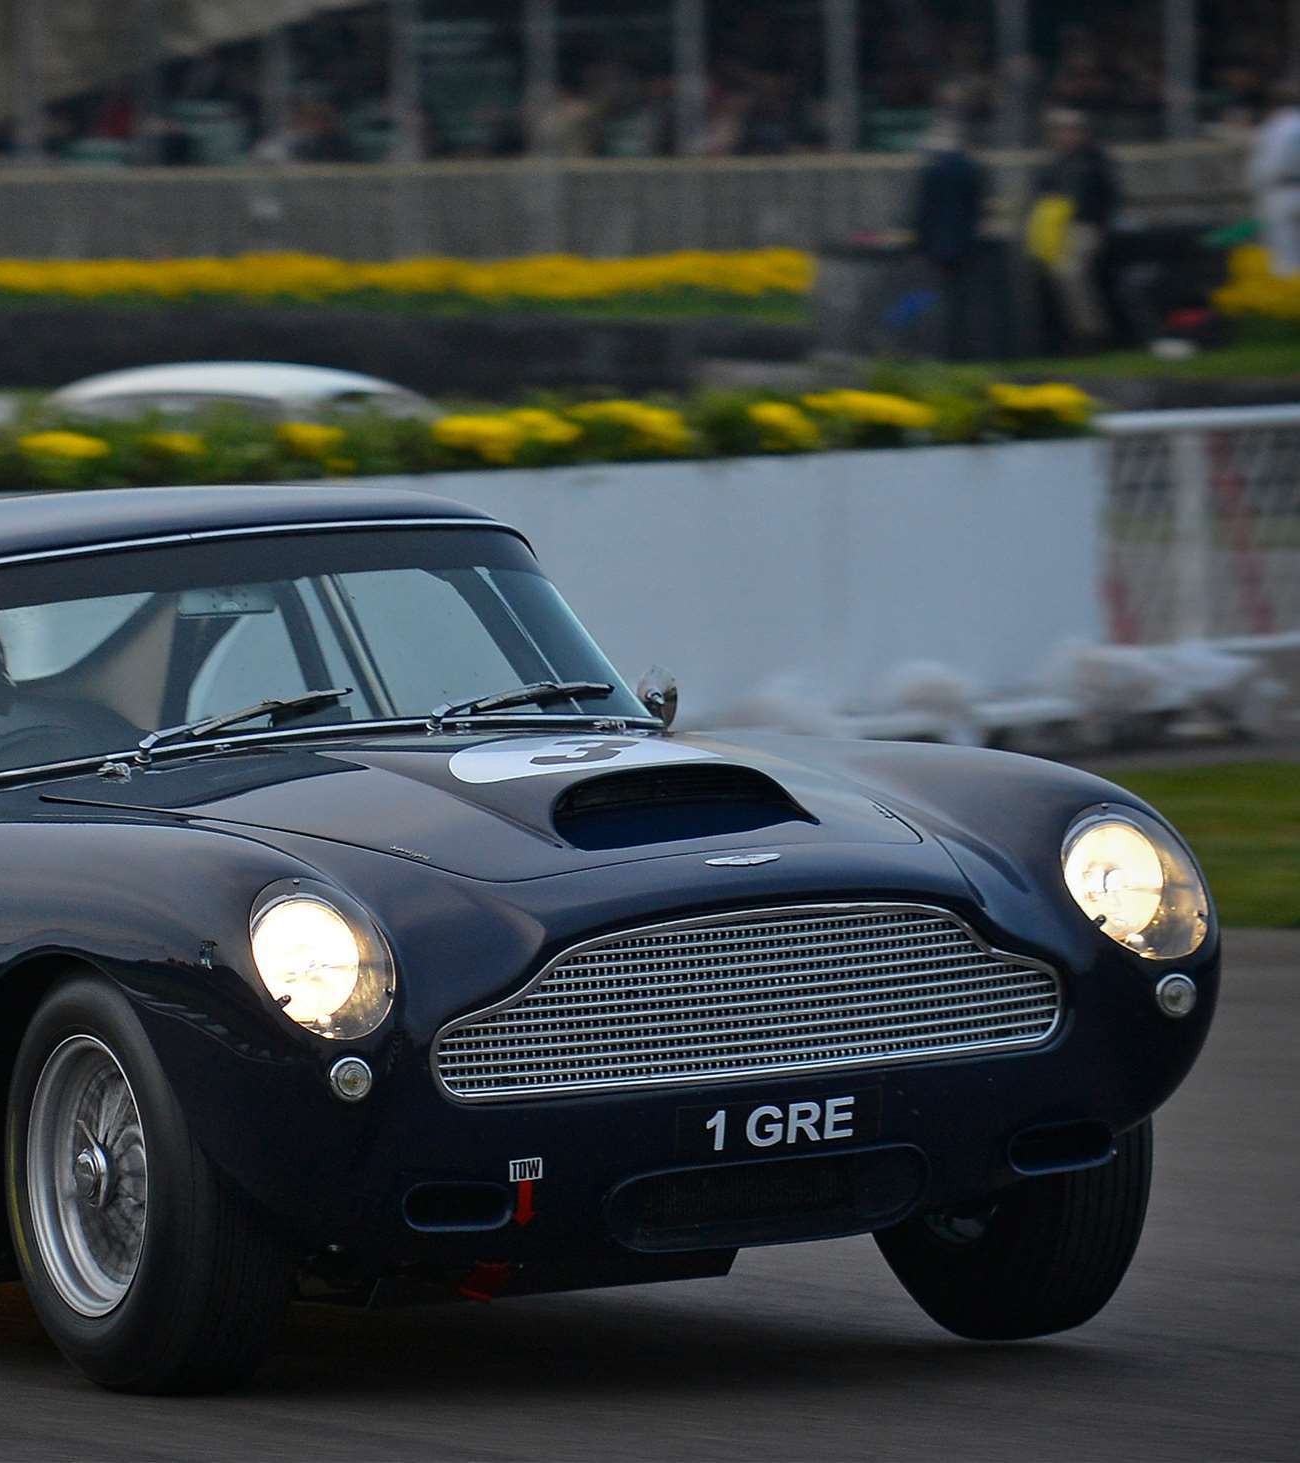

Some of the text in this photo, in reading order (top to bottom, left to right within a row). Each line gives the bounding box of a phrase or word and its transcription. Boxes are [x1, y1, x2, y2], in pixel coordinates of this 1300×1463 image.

[529, 739, 640, 766] 3
[706, 1096, 855, 1151] 1 GRE
[511, 1159, 541, 1180] TOW
